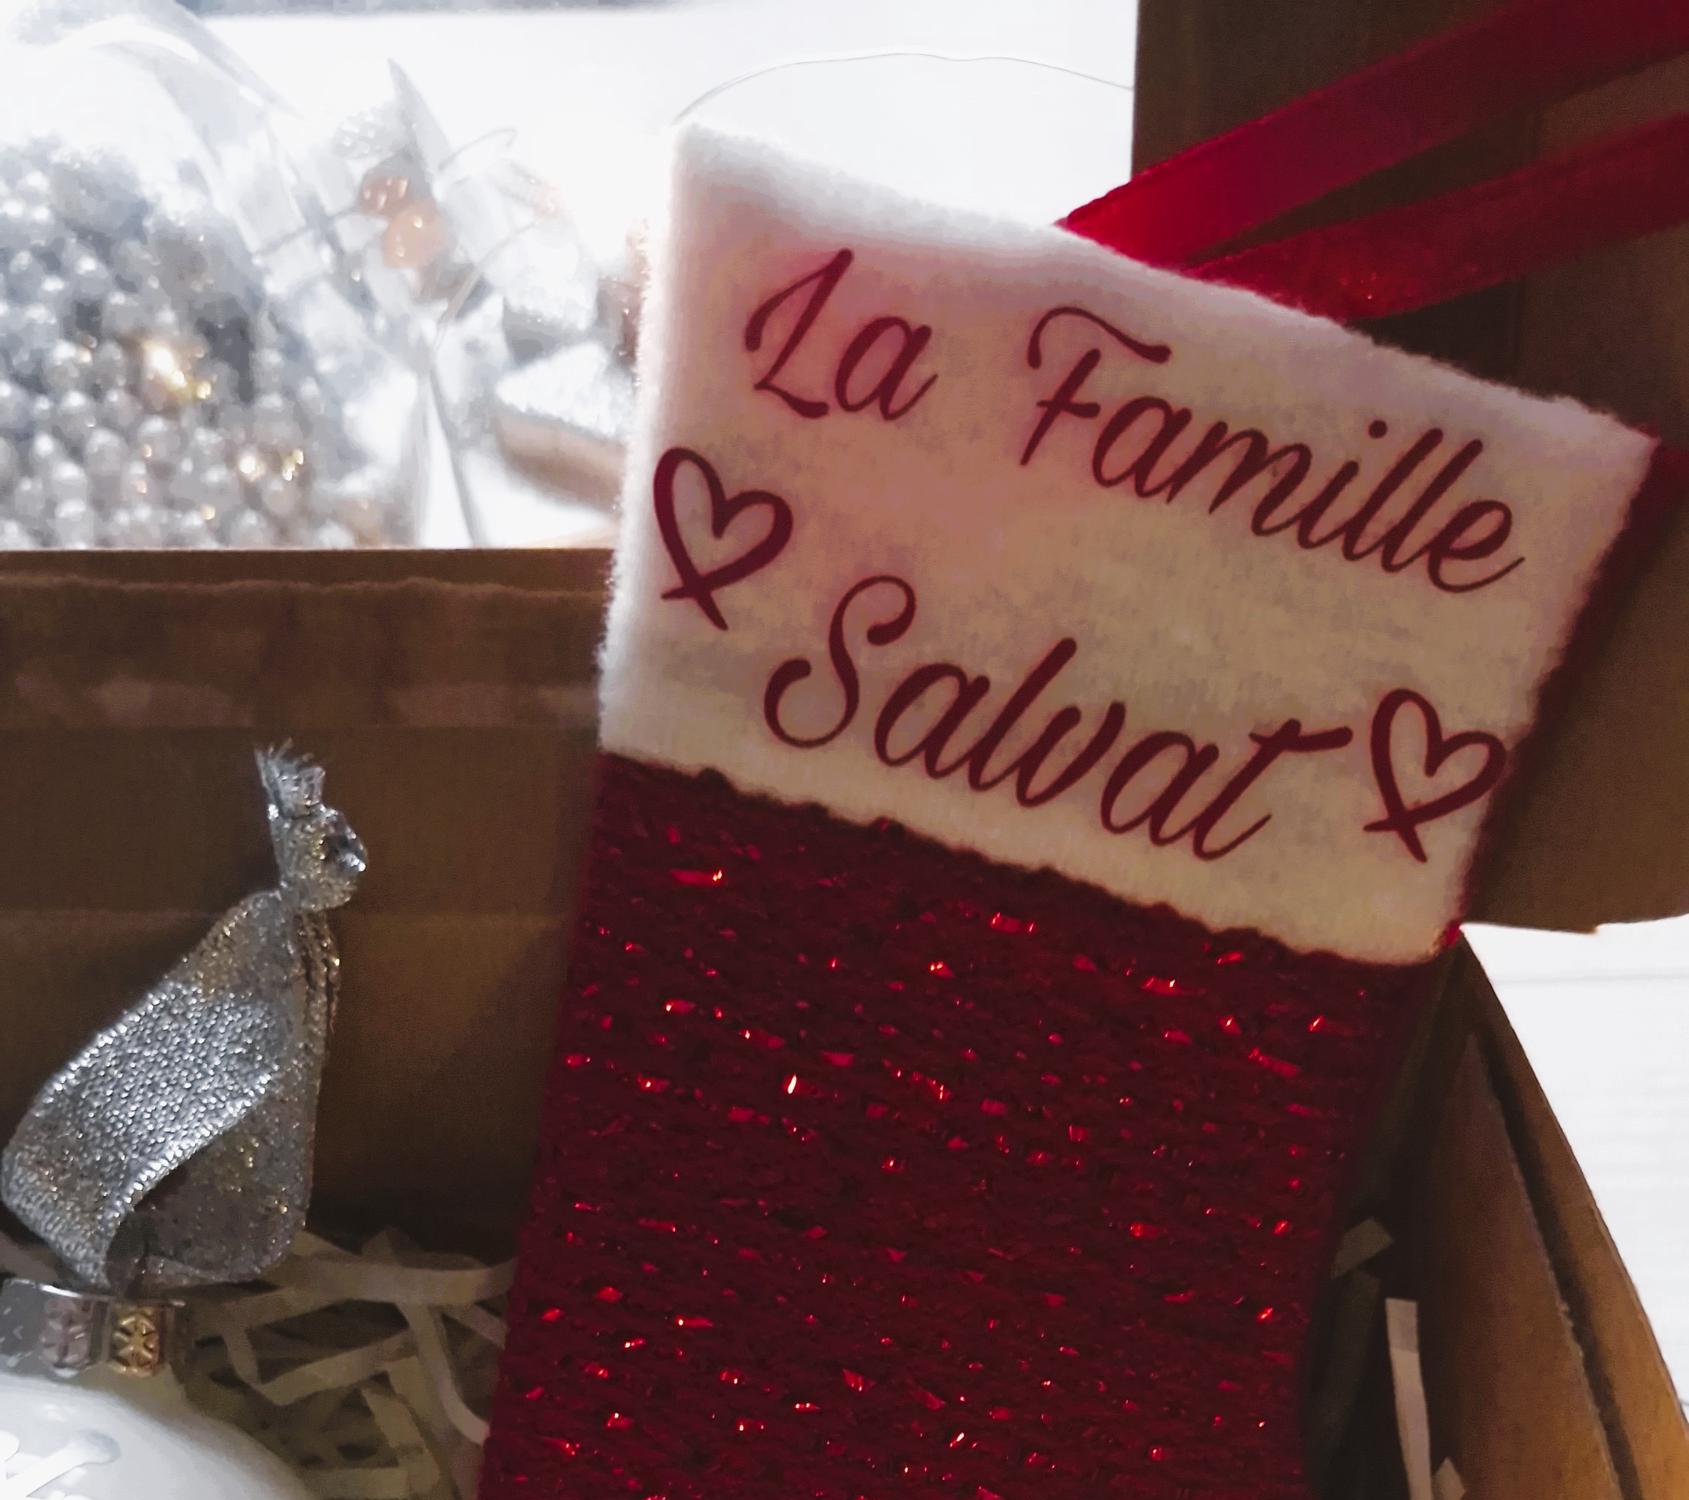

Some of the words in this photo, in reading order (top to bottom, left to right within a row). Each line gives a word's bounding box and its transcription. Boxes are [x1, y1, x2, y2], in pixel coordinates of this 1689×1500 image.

[744, 248, 938, 422] La
[1019, 305, 1526, 594] Famille
[763, 574, 1354, 862] Salvat
